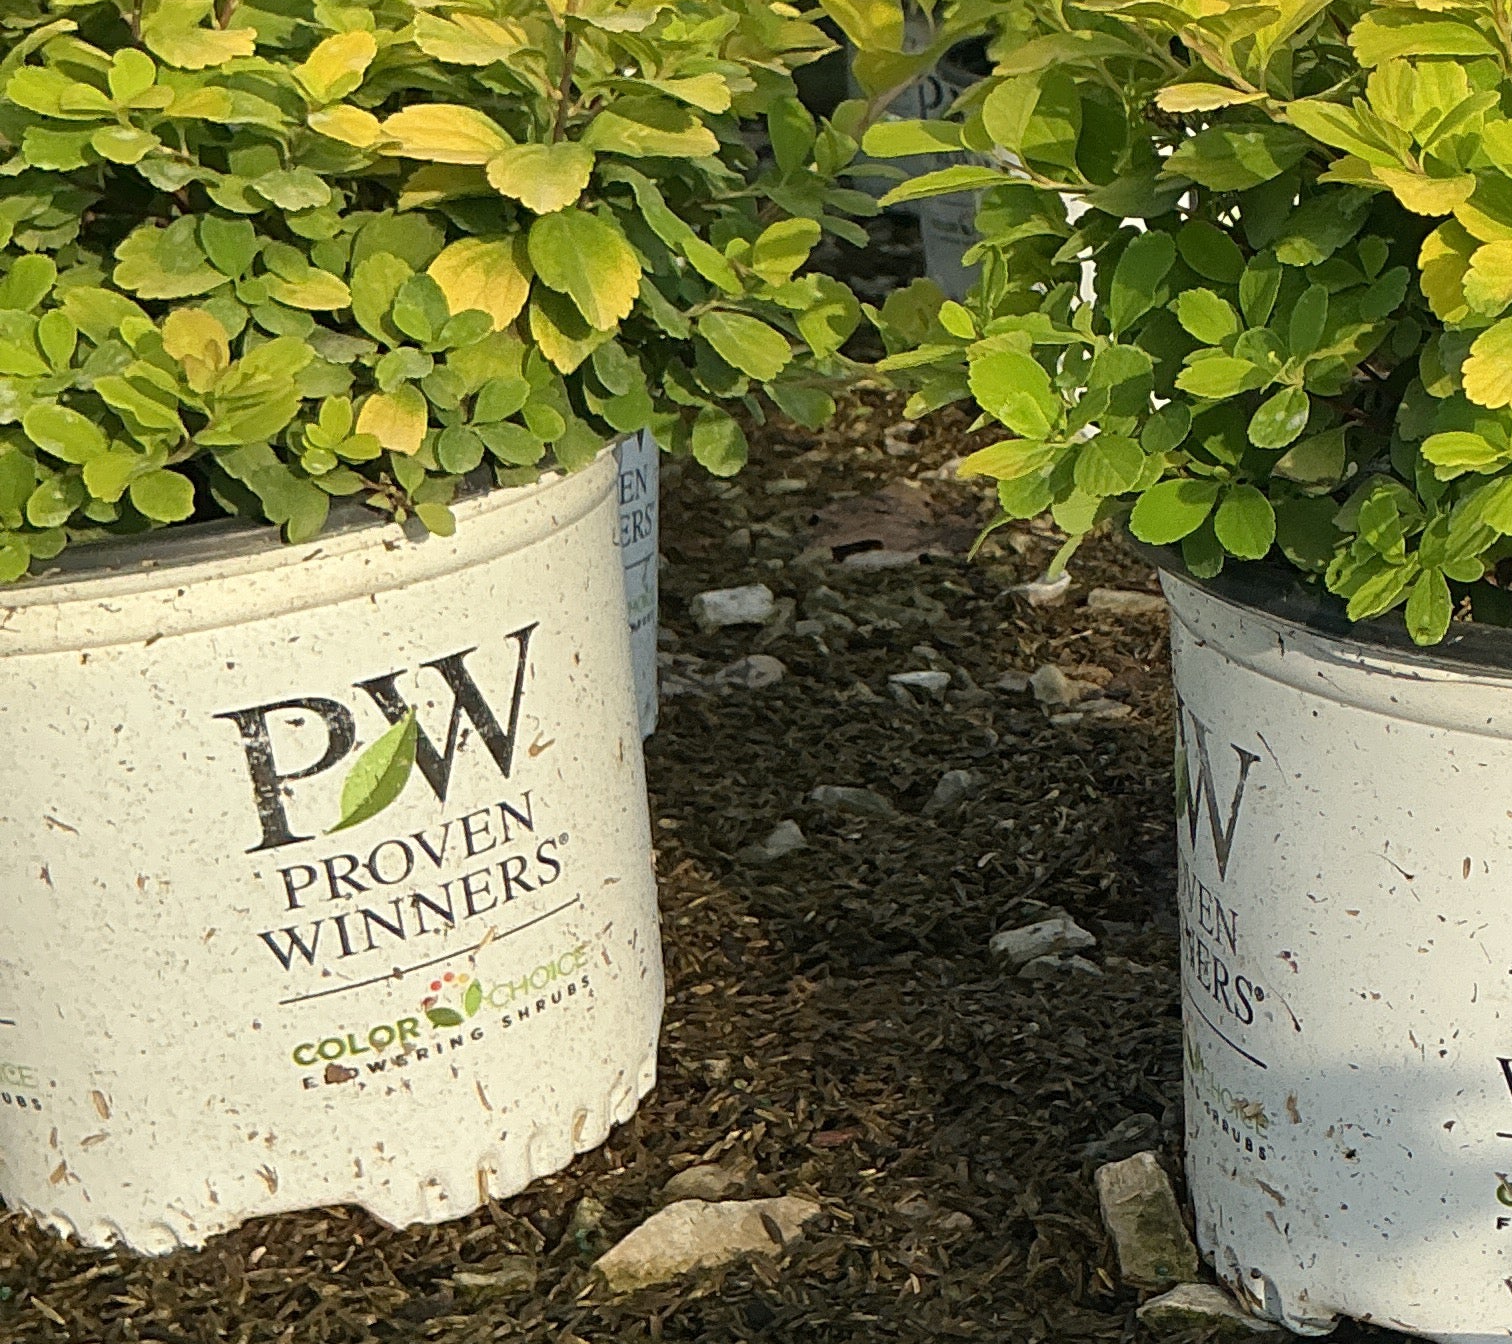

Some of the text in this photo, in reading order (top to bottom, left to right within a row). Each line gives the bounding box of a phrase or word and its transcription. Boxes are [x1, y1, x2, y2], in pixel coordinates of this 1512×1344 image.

[212, 621, 540, 855] PW
[1177, 687, 1260, 883] W
[276, 789, 535, 911] PROVEN
[292, 943, 589, 1067] COLOR CHOICE
[501, 974, 591, 1029] SHRUBS
